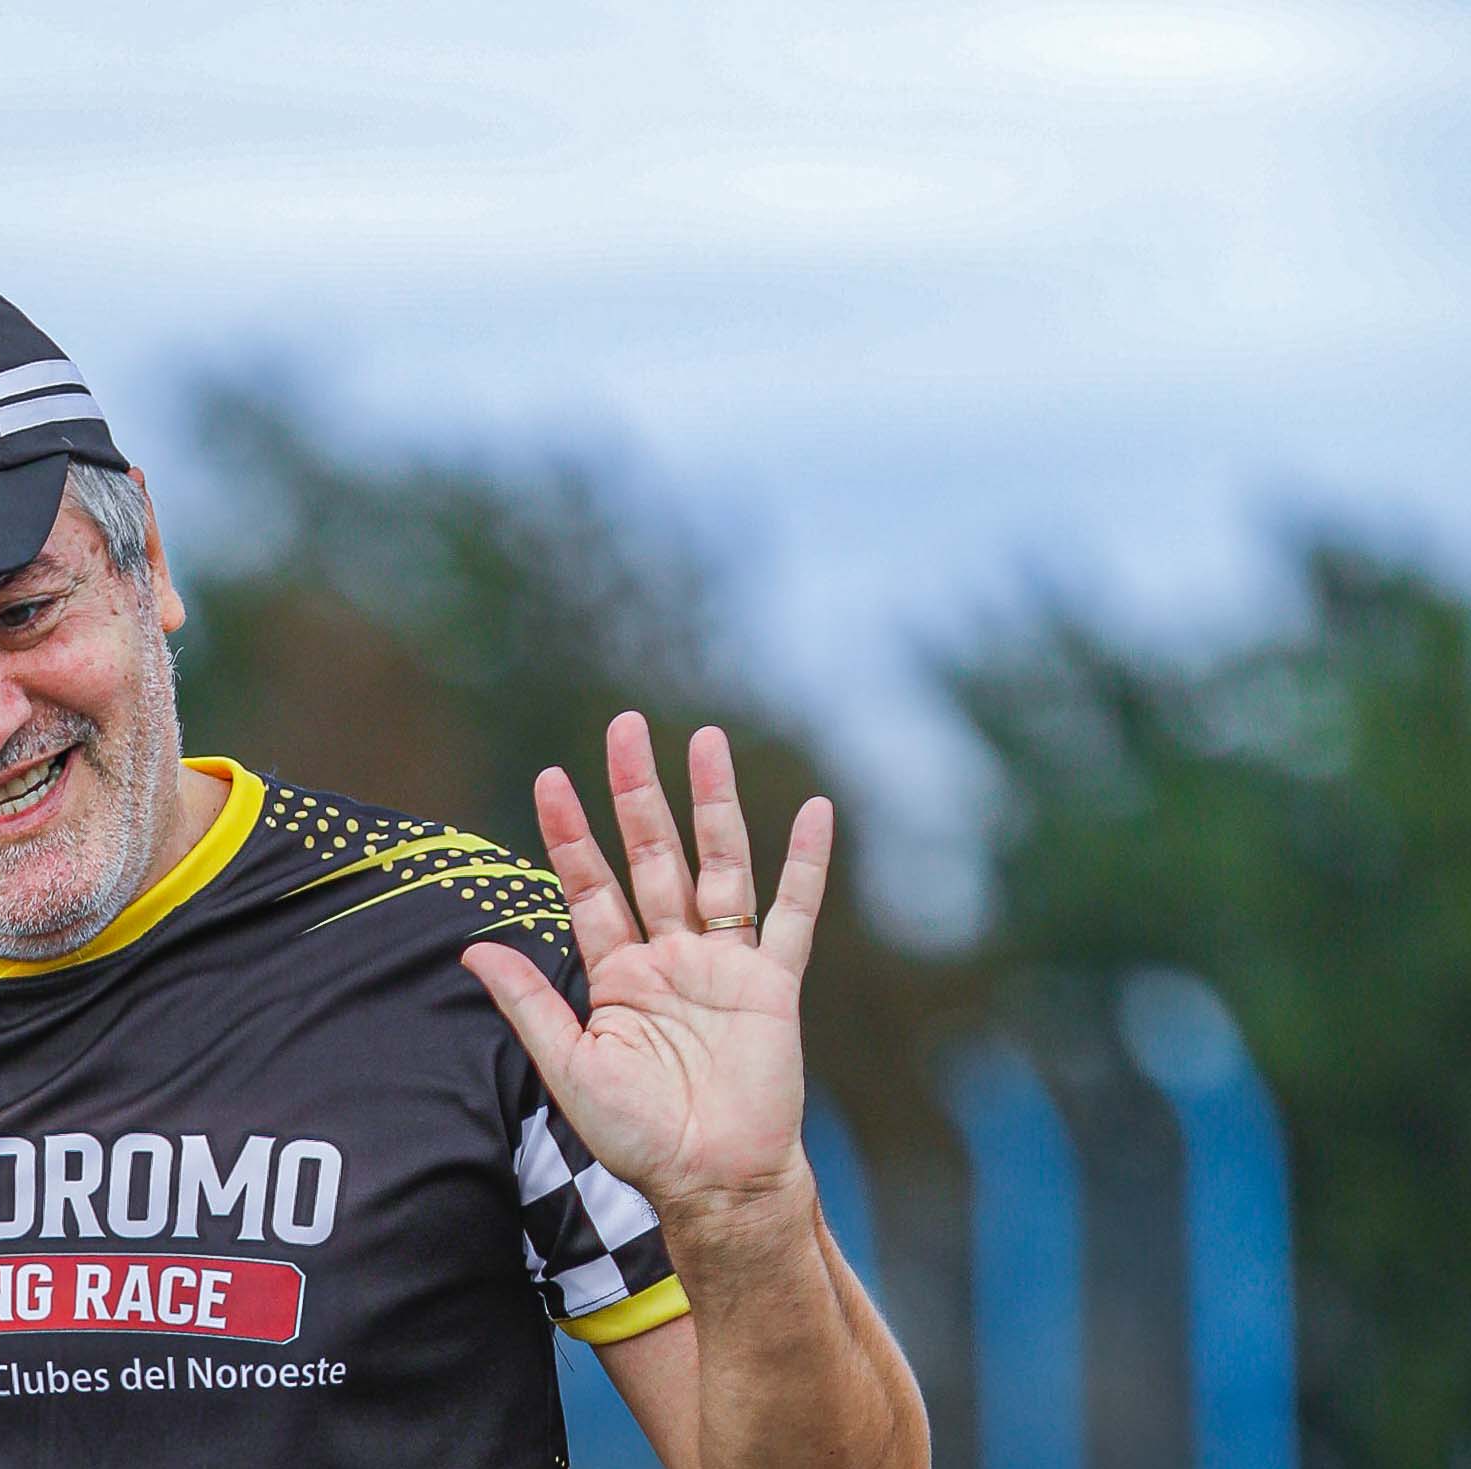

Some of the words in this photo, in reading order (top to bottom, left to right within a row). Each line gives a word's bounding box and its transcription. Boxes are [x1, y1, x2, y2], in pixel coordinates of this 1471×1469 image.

[73, 1263, 233, 1329] RACE
[120, 1356, 176, 1390] del
[187, 1356, 347, 1390] Noroeste
